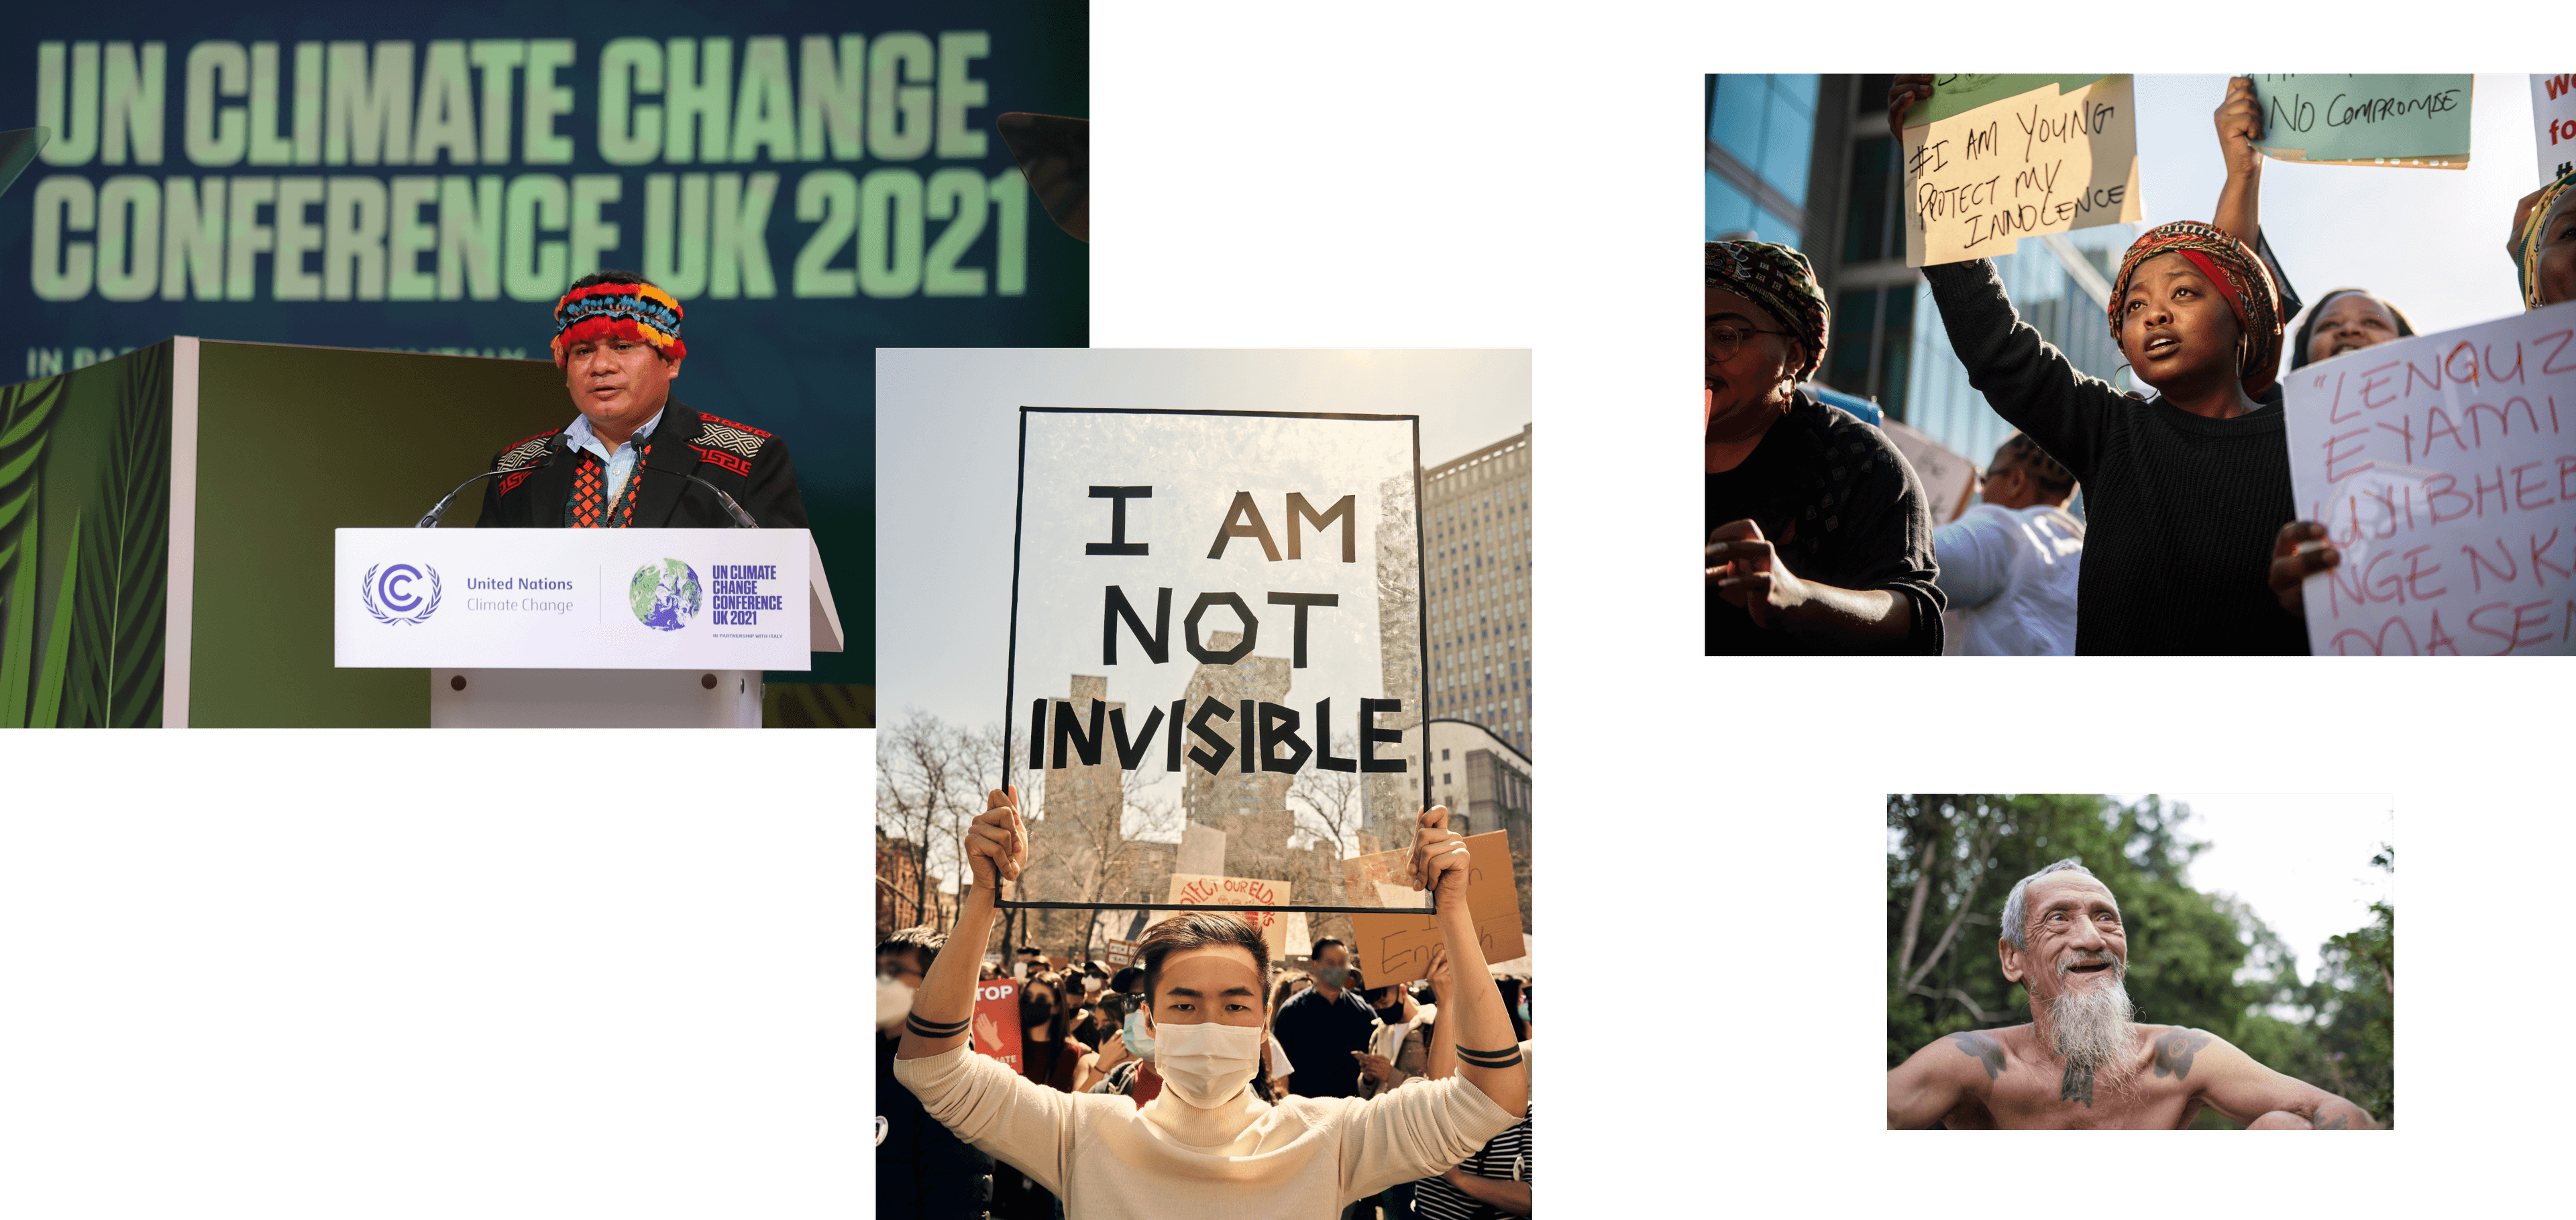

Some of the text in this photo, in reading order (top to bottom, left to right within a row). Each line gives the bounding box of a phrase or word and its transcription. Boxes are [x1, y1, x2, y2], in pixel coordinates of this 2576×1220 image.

[37, 31, 990, 167] UN CLIMATE CHANGE
[2269, 93, 2315, 132] NO
[1967, 121, 1997, 160] AM
[2017, 100, 2114, 163] YOUNG
[2015, 159, 2061, 200] MY
[31, 166, 1028, 302] CONFERENCE UK 2021
[1085, 485, 1356, 563] I AM
[468, 577, 573, 590] United Nations
[712, 565, 777, 579] UN CLIMATE
[712, 580, 757, 595] CHANGE
[468, 598, 574, 615] Climate Change
[712, 595, 783, 610] CONFERENCE
[712, 610, 757, 625] UK 2021
[1103, 585, 1339, 669] NOT
[1029, 696, 1407, 776] INVISIBLE
[1224, 880, 1248, 893] OUR
[1248, 881, 1275, 927] ELDRS
[976, 985, 1013, 1001] TOP
